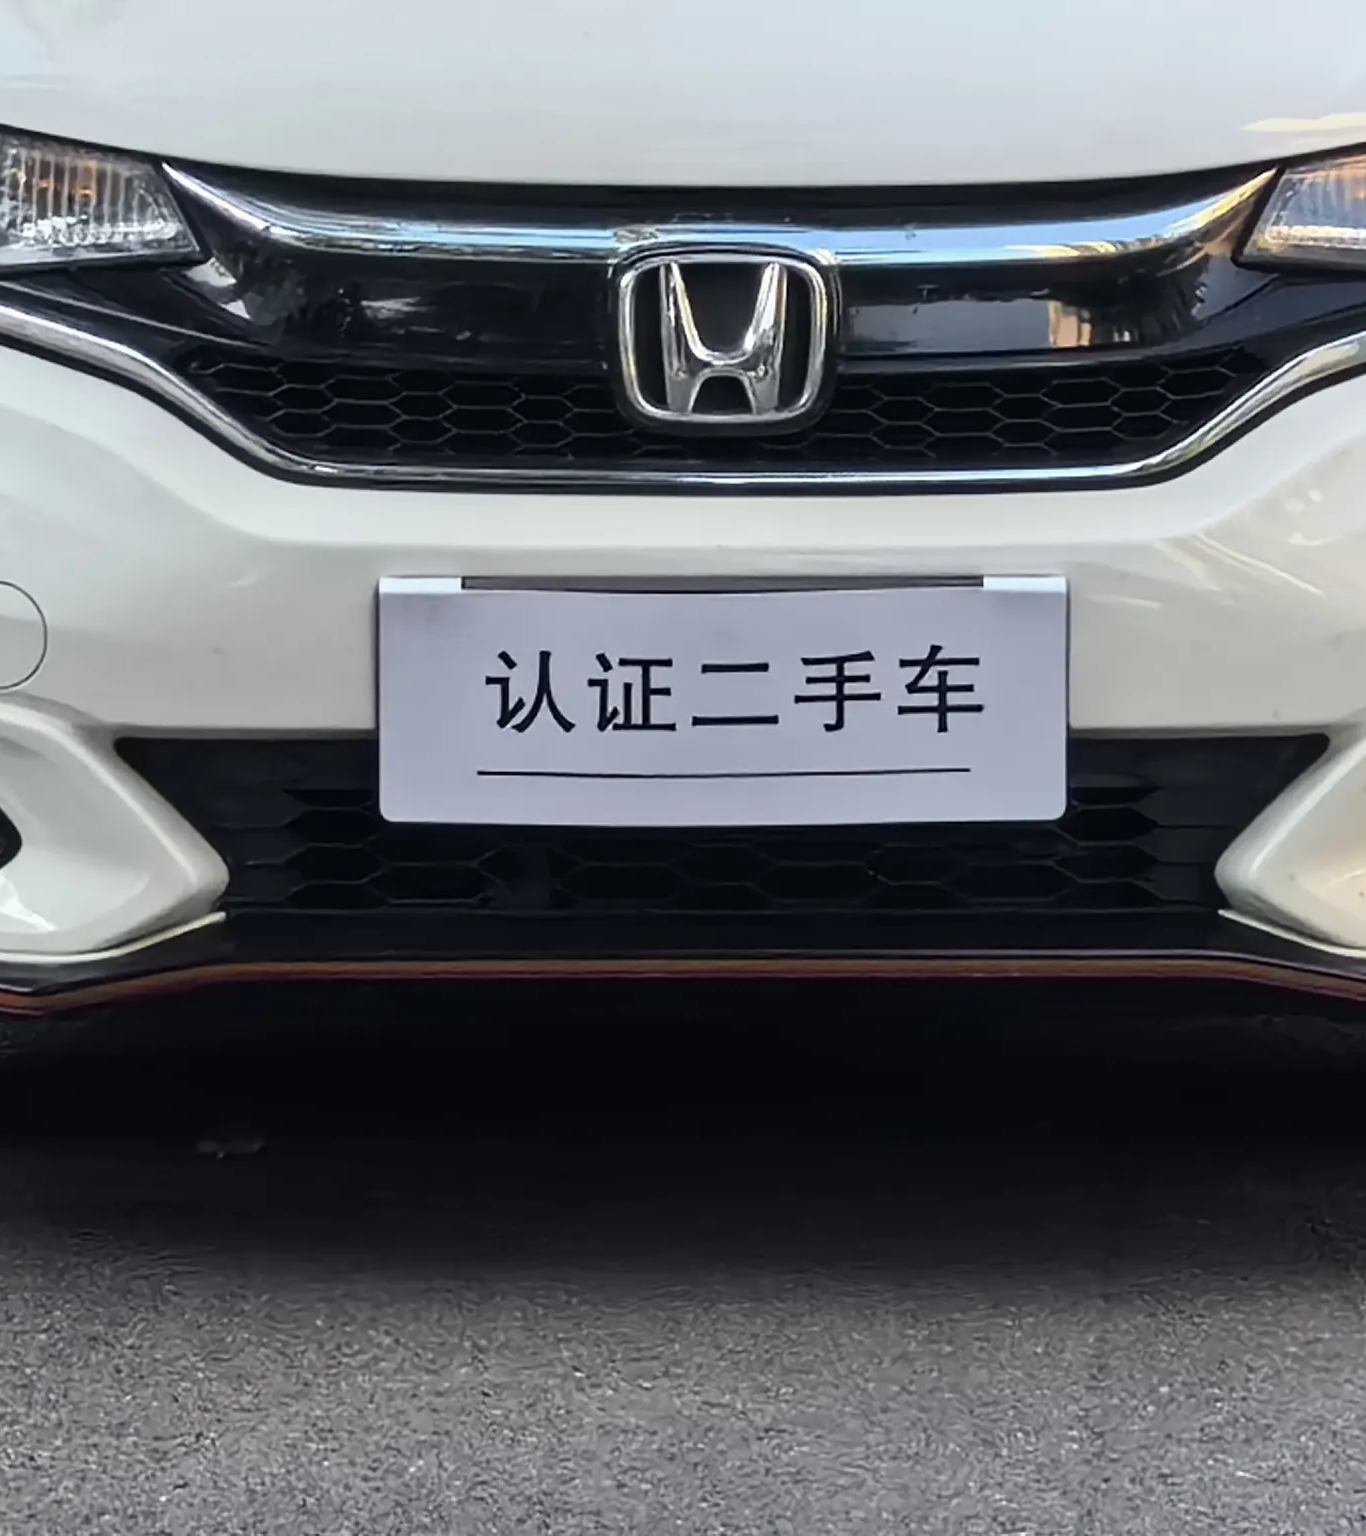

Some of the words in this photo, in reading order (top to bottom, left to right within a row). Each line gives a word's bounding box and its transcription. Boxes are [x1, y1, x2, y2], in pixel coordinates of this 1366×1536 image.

[484, 644, 985, 734] 认证二手车
